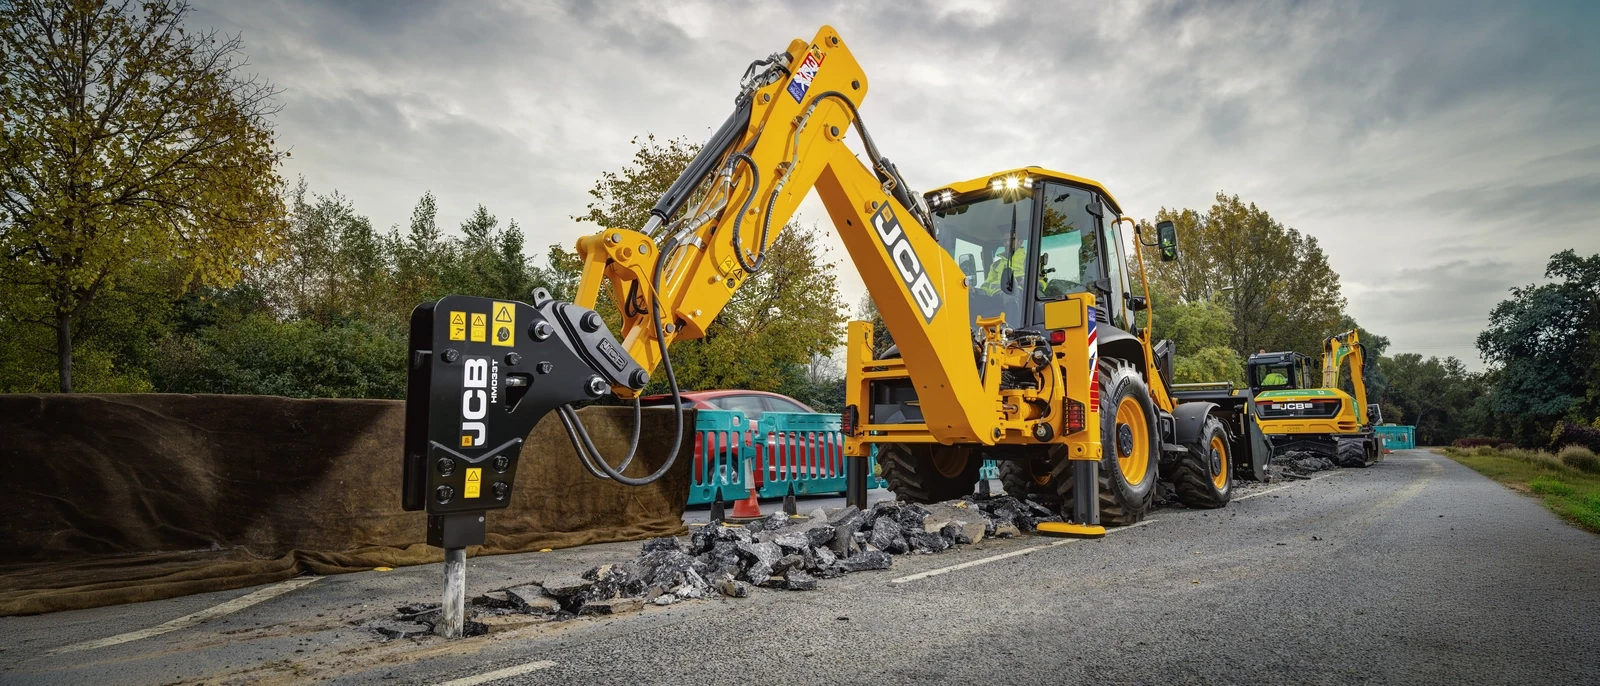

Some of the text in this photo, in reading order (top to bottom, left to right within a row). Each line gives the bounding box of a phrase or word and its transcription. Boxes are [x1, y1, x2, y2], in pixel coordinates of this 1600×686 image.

[874, 213, 940, 319] JCB
[600, 339, 627, 369] JCB
[462, 358, 488, 446] JCB
[490, 359, 499, 404] HM033T
[1280, 402, 1305, 410] JCB
